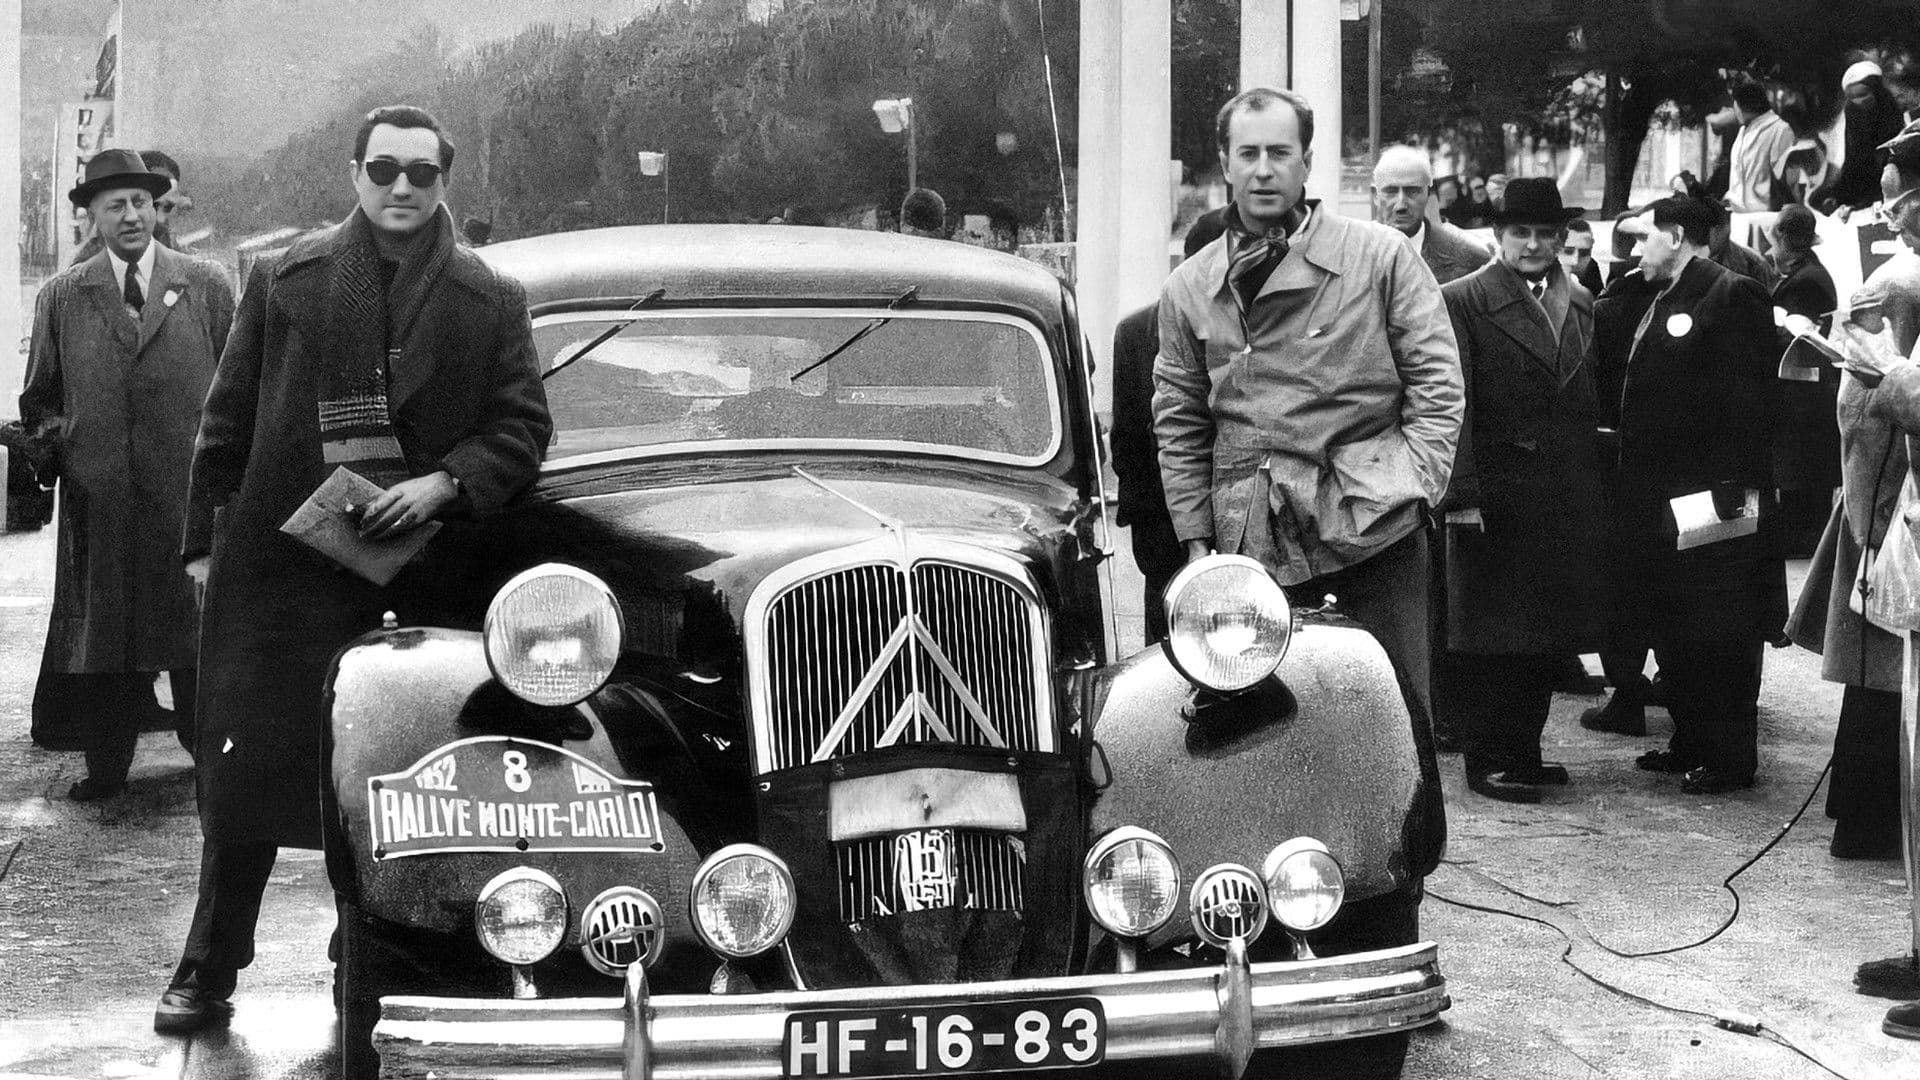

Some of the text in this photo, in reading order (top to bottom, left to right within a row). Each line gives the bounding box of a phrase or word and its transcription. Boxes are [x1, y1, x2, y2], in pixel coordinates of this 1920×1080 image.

[502, 750, 532, 792] 8
[380, 788, 652, 843] RALLYE MONTE-CARLO
[790, 1008, 1099, 1076] HF-16-83
